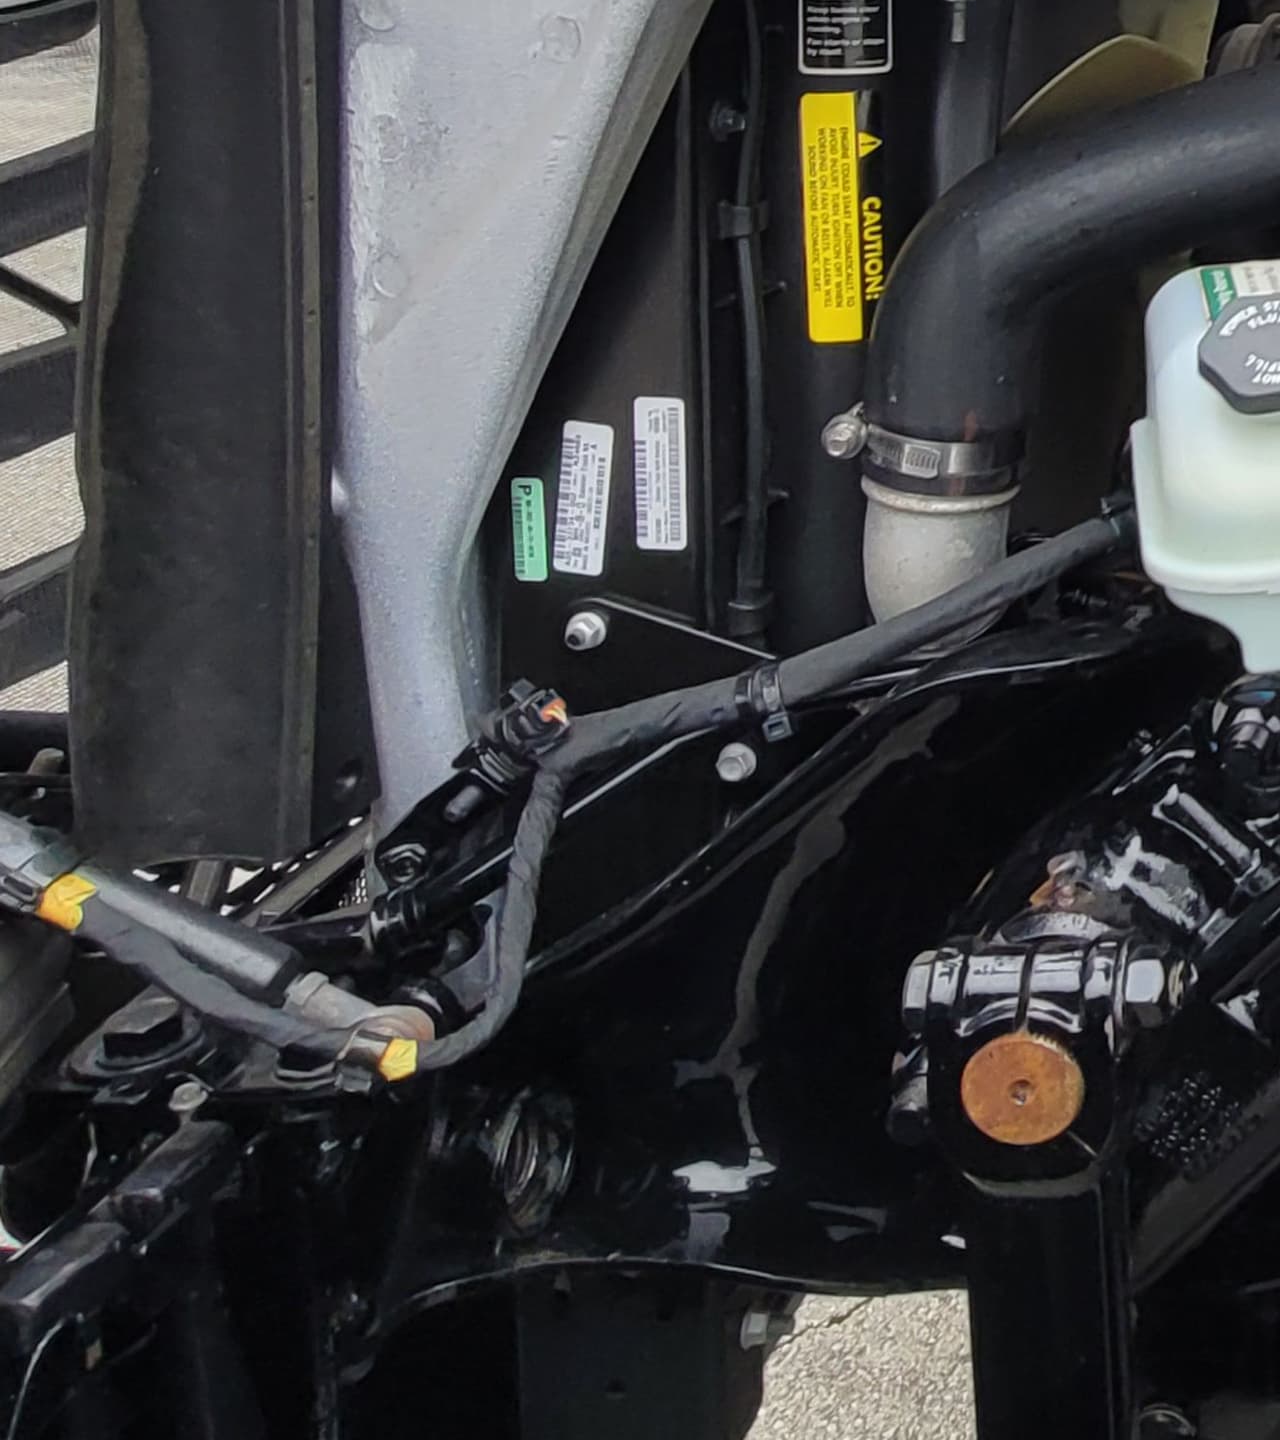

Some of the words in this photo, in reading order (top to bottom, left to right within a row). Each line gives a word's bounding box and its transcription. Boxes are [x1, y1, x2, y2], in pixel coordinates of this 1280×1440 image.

[818, 128, 827, 172] WORKING
[830, 128, 838, 155] AVOID
[810, 180, 818, 211] BEFORE
[820, 175, 828, 189] ON
[822, 212, 830, 224] OR
[843, 195, 852, 219] START
[811, 215, 820, 264] AUTOMATIC
[833, 219, 841, 259] IGNITION
[862, 196, 885, 301] CAUTION:
[834, 262, 842, 277] OFF
[824, 289, 832, 308] WILL
[835, 281, 843, 308] WHEN
[847, 296, 855, 307] TO
